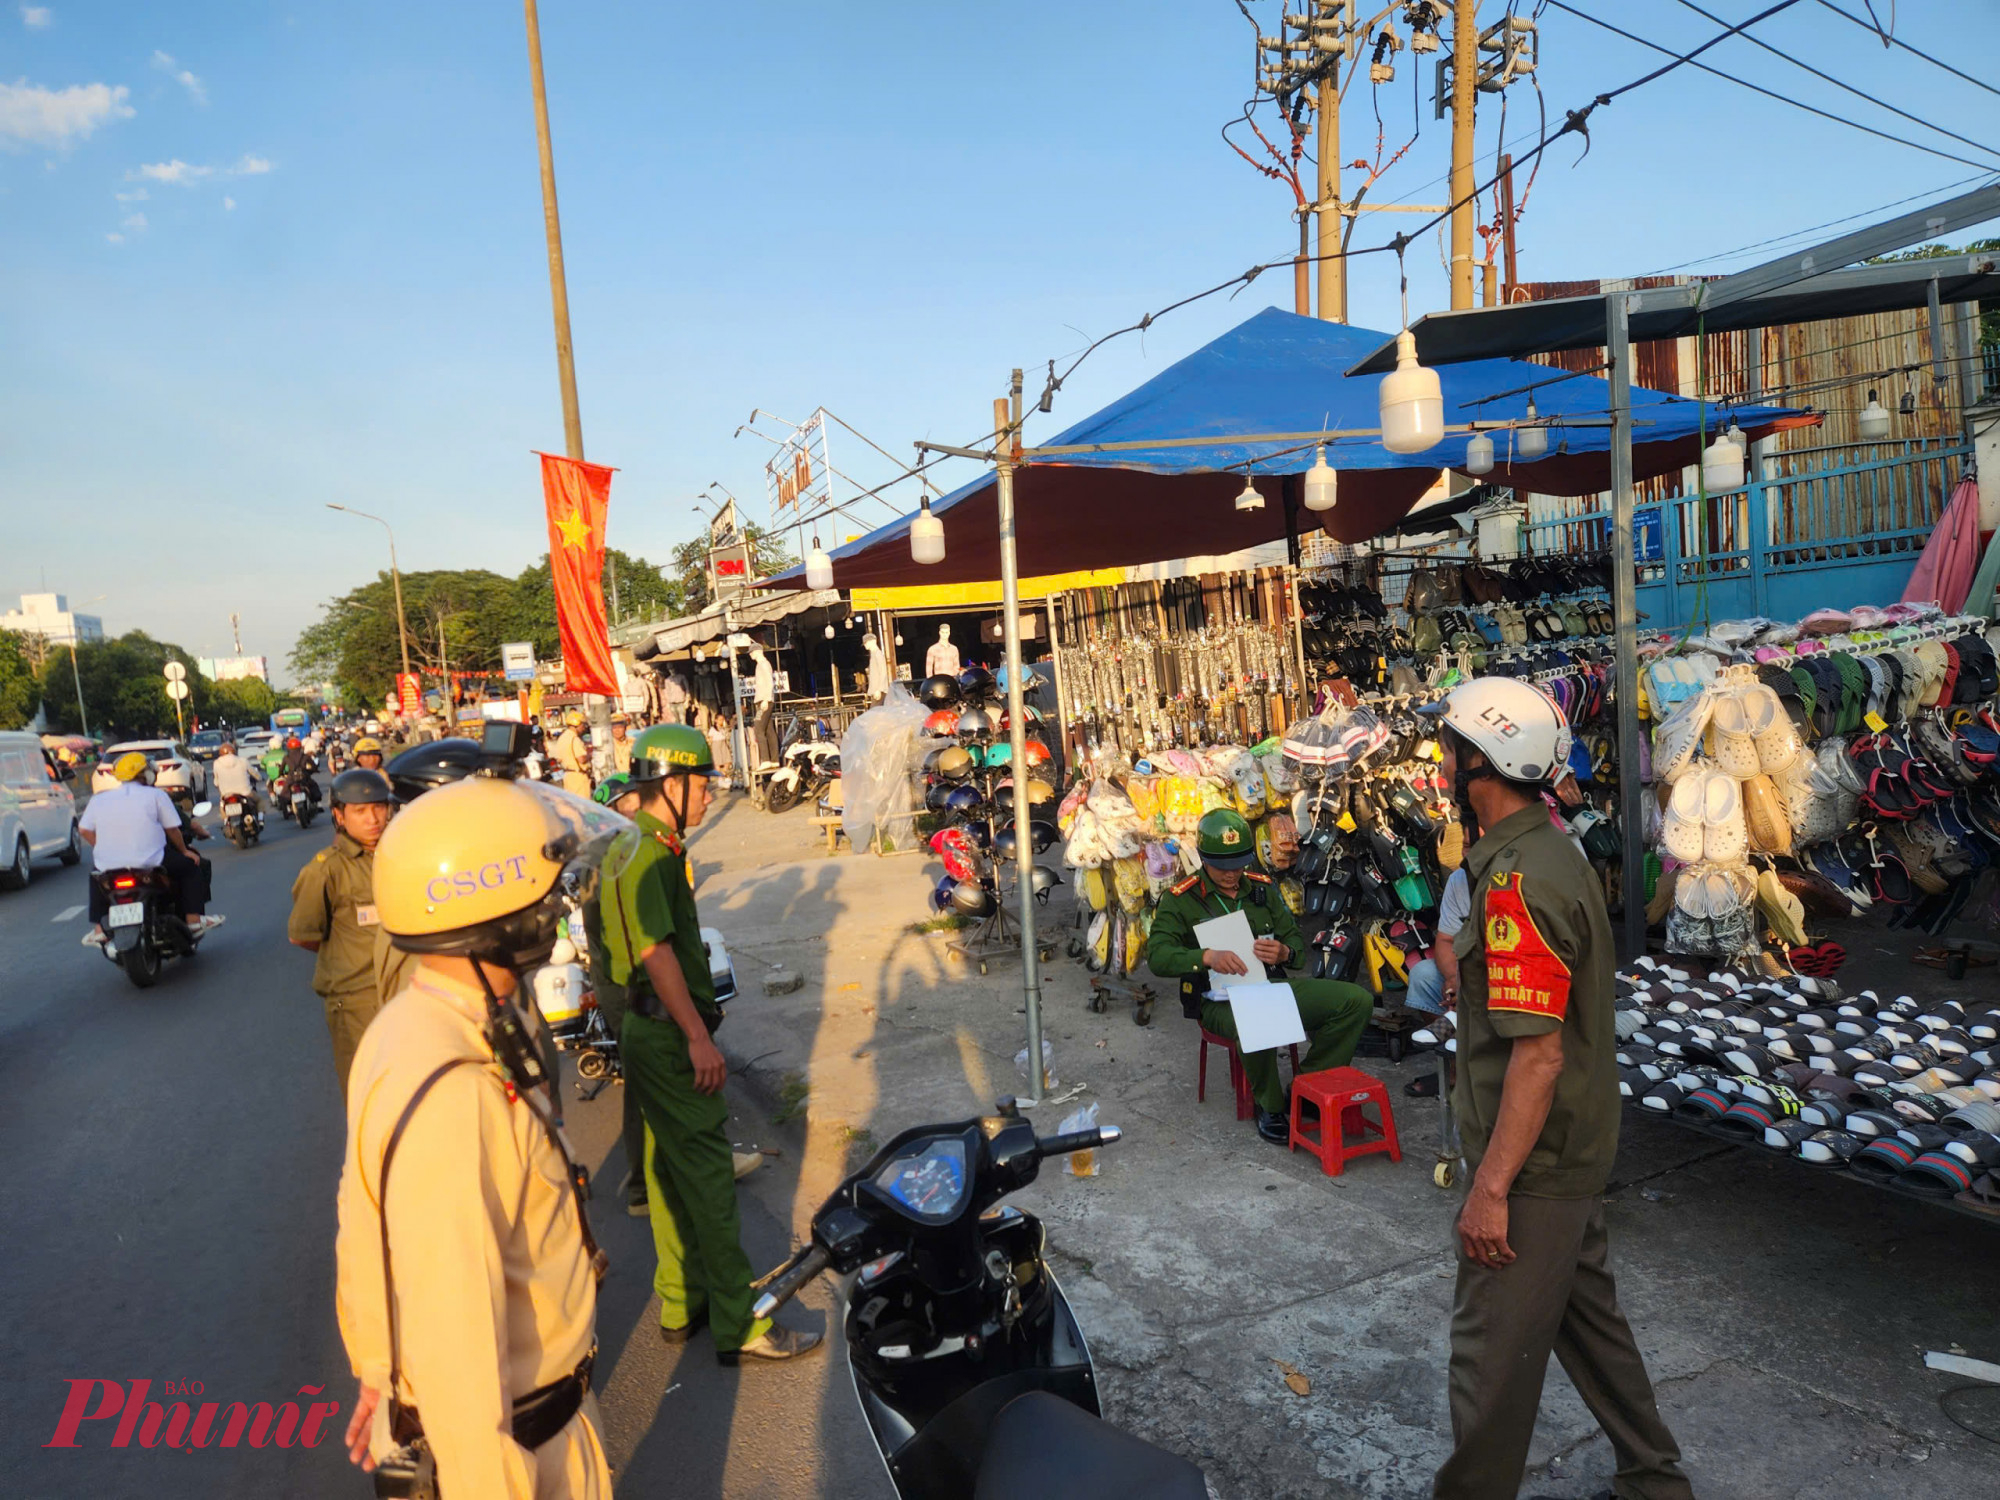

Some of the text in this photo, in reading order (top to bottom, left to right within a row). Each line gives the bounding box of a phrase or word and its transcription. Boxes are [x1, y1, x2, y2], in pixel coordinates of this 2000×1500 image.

[716, 559, 745, 575] 3M
[646, 746, 697, 766] POLICE
[427, 855, 526, 903] CSGT
[1506, 964, 1521, 984] VỆ
[1504, 985, 1533, 1005] TRẬT
[1536, 990, 1551, 1008] TỰ
